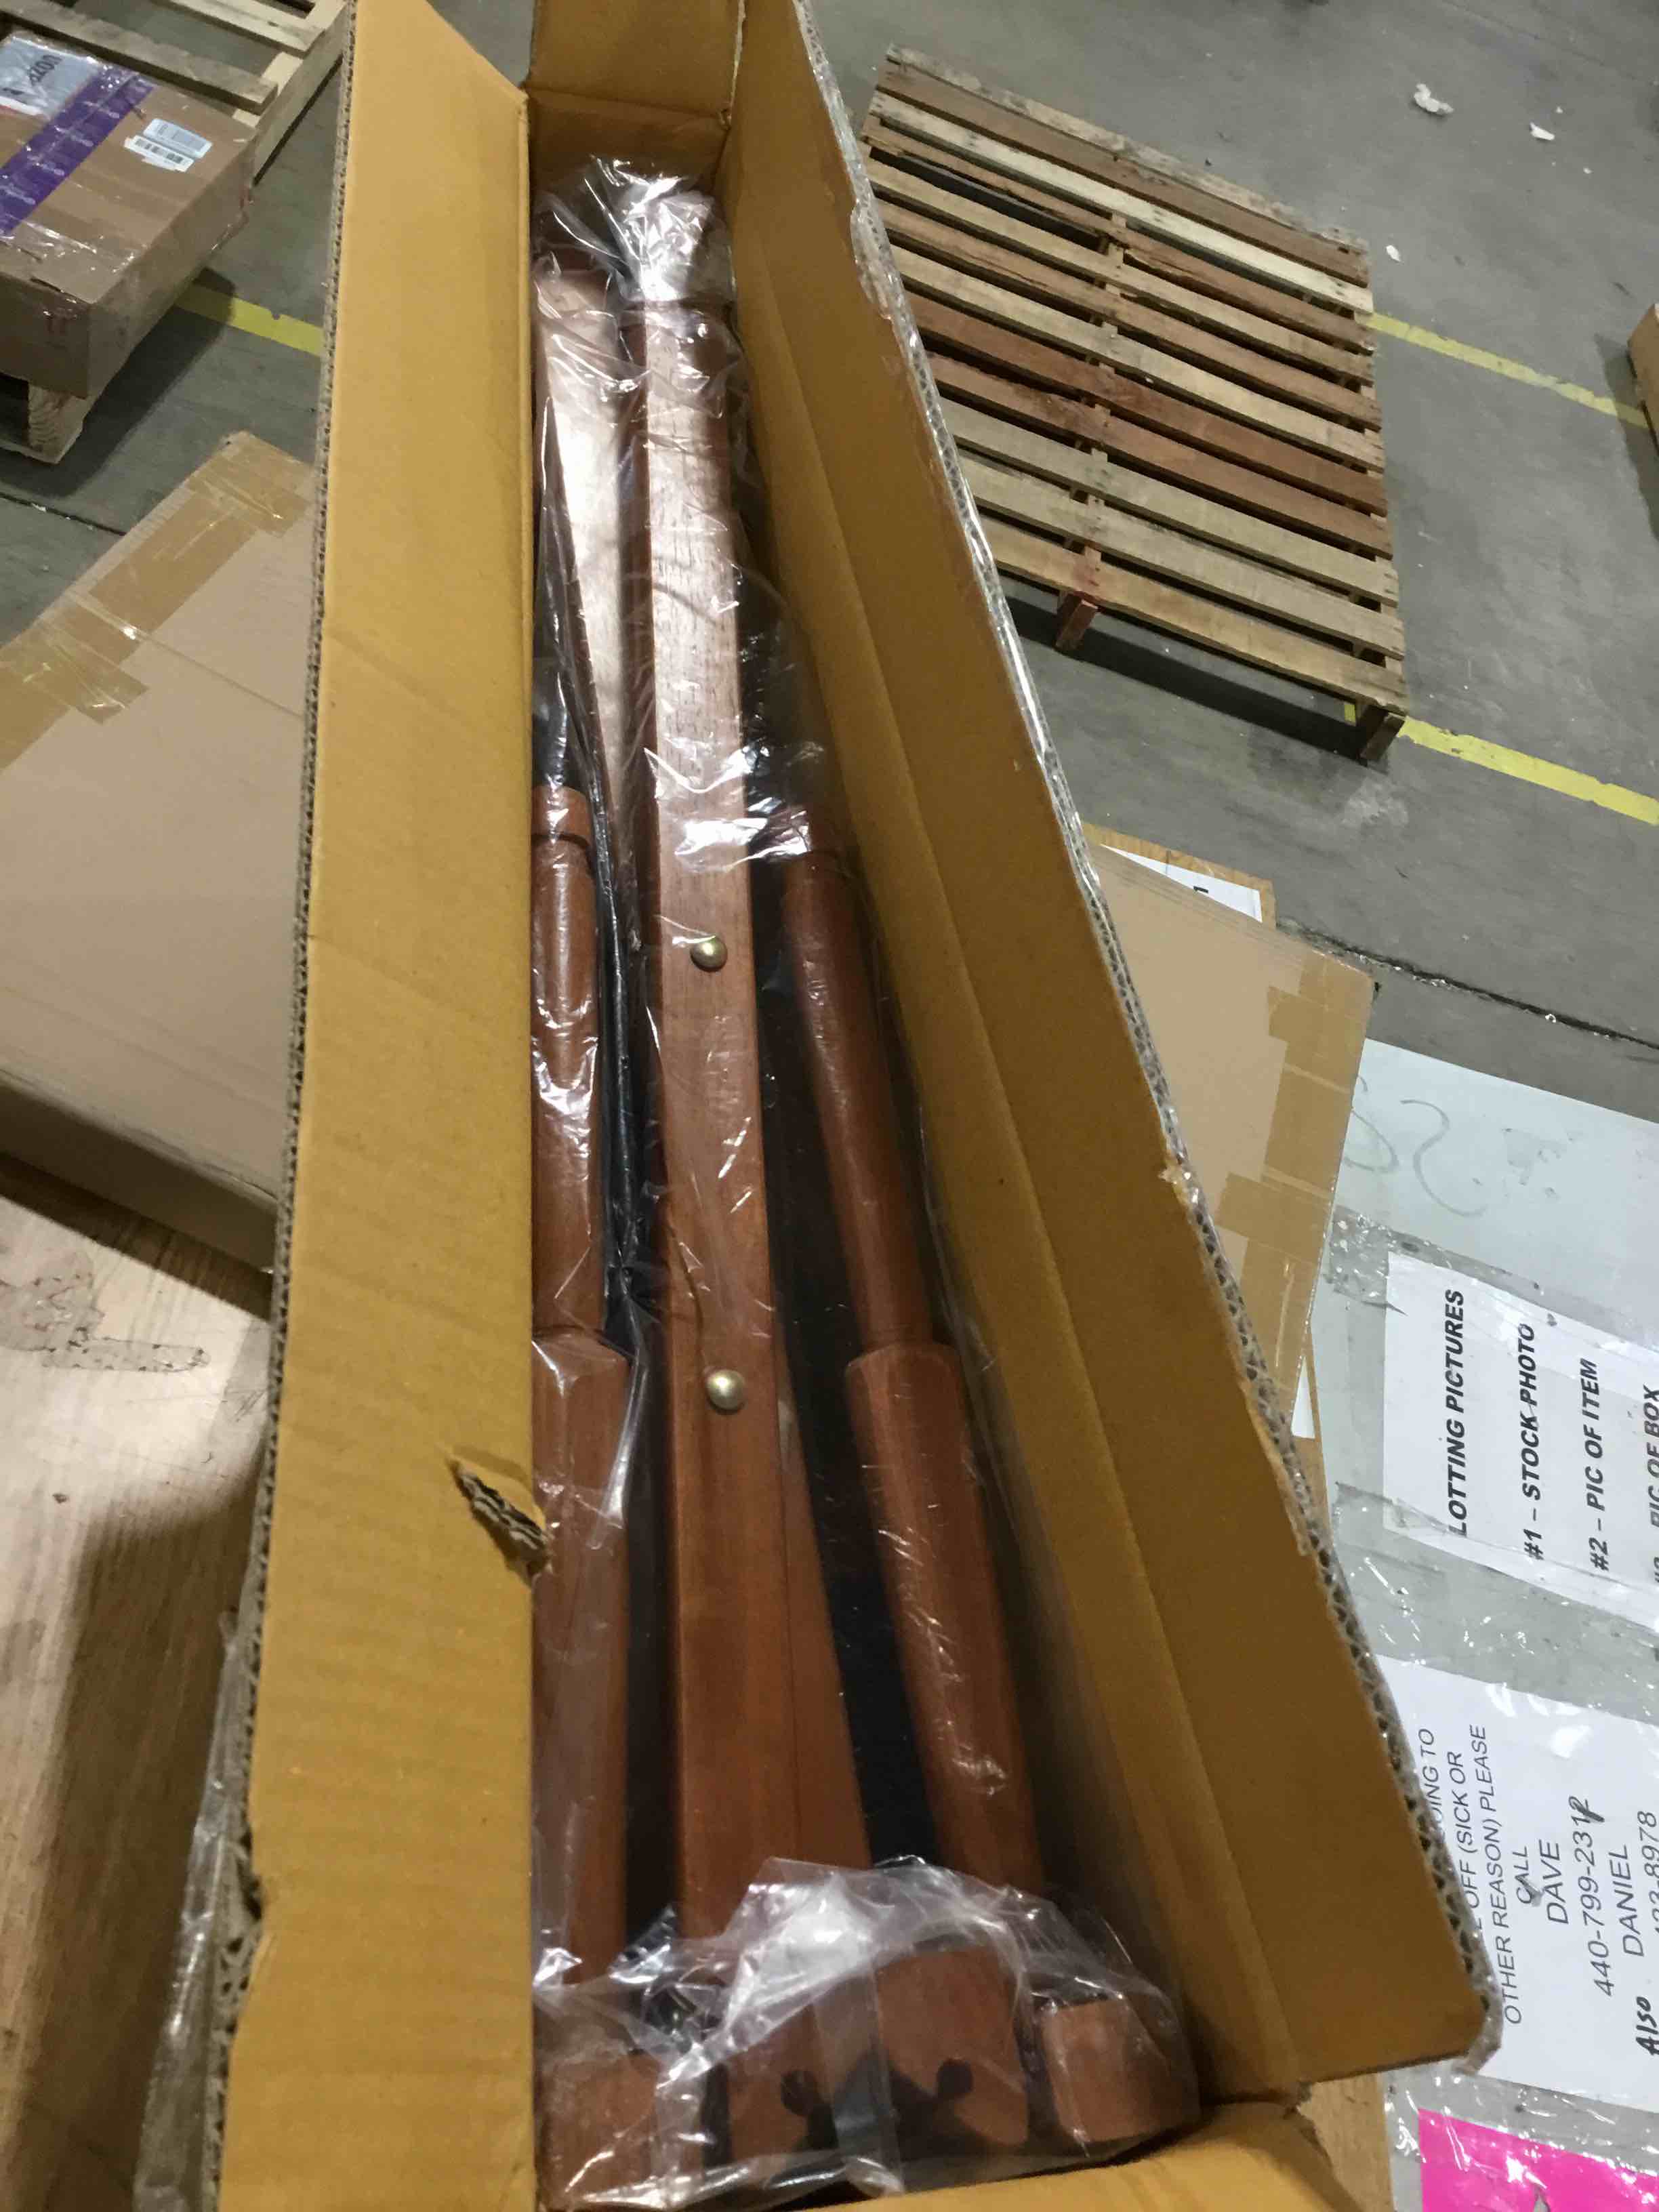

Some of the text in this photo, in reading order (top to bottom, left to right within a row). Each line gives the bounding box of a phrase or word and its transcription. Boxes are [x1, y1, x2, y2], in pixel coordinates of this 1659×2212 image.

[1517, 1324, 1536, 1407] PHOTO
[1580, 1359, 1600, 1421] ITEM
[1445, 1289, 1468, 1536] LOTTING PICTURES
[1584, 1424, 1603, 1459] OF
[1643, 1385, 1659, 1438] BOX
[1520, 1412, 1540, 1502] STOCK
[1584, 1467, 1605, 1512] PIC
[1524, 1529, 1544, 1560] #1
[1590, 1537, 1610, 1572] #2
[1418, 1729, 1436, 1757] TO
[1448, 1751, 1481, 1908] OFF (SICK OR
[1469, 1724, 1522, 2024] OTHER REASON) PLEASE
[1512, 1845, 1533, 1904] CALL
[1539, 1839, 1569, 1925] DAVE
[1609, 1844, 1644, 1957] DANIEL
